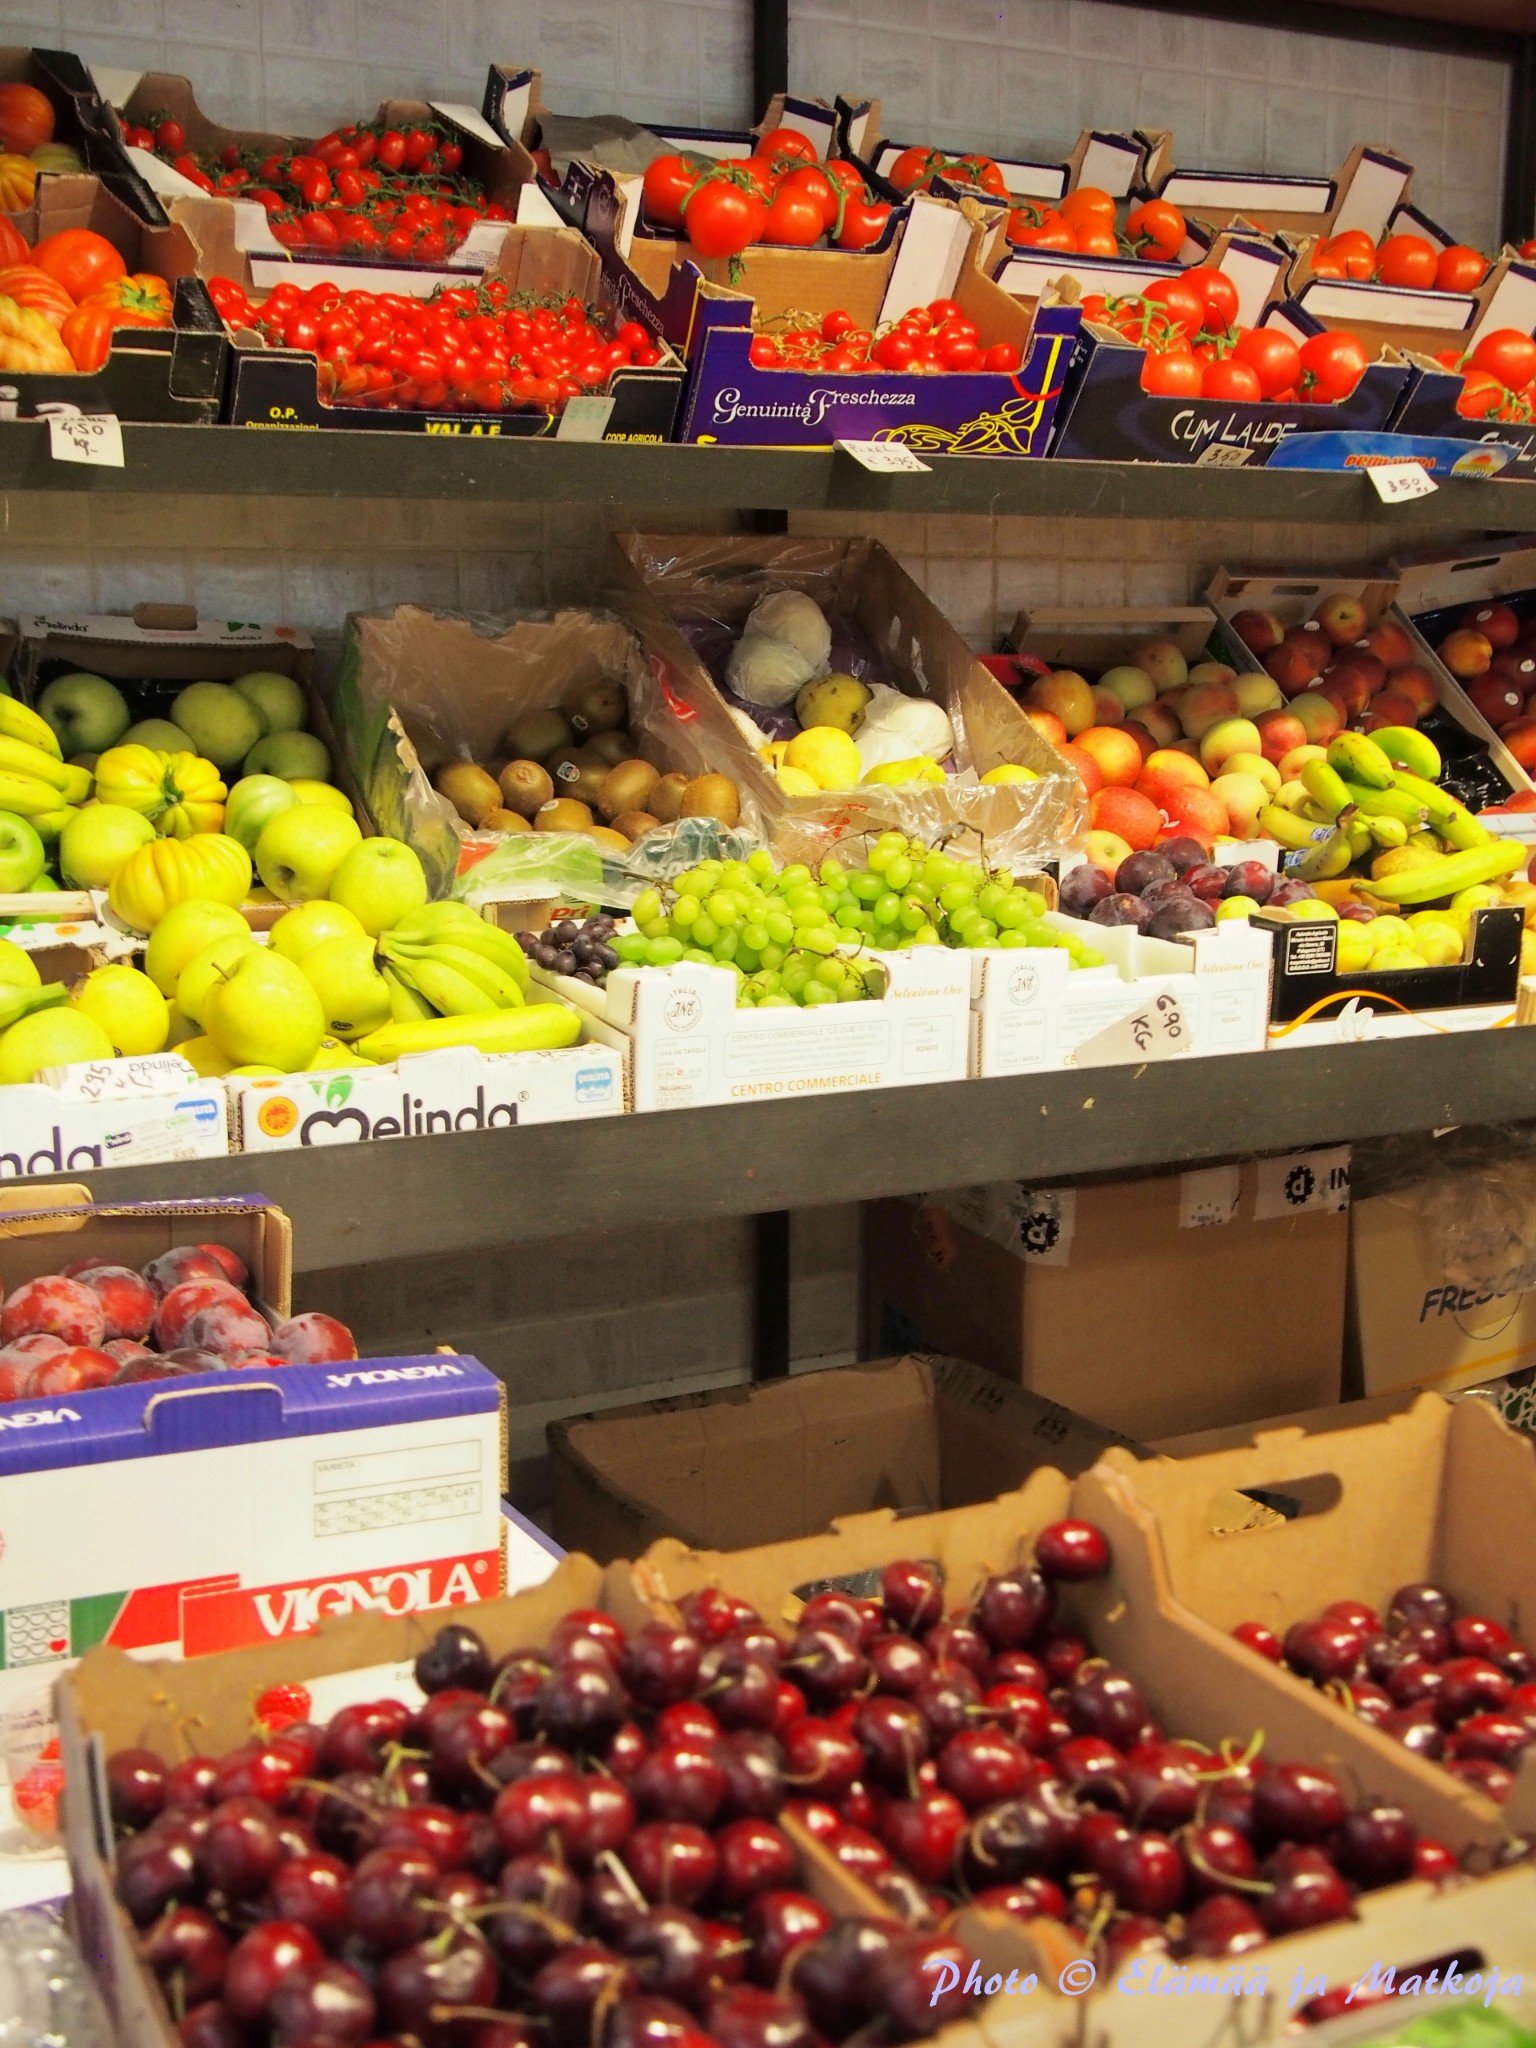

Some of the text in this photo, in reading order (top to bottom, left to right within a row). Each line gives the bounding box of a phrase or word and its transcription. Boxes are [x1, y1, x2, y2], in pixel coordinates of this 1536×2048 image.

[269, 406, 299, 420] O.P.
[712, 387, 916, 427] Genuinità Freschezza
[605, 433, 663, 444] COOP AGRICOLA
[1171, 410, 1220, 453] CUM
[1131, 1014, 1154, 1051] KG
[1156, 994, 1182, 1039] 6.90
[731, 1032, 765, 1043] CENTRO
[767, 1029, 824, 1040] COMMERCIALE
[732, 1072, 882, 1097] CENTRO COMMERCIALE
[252, 1562, 482, 1637] VIGNOLA
